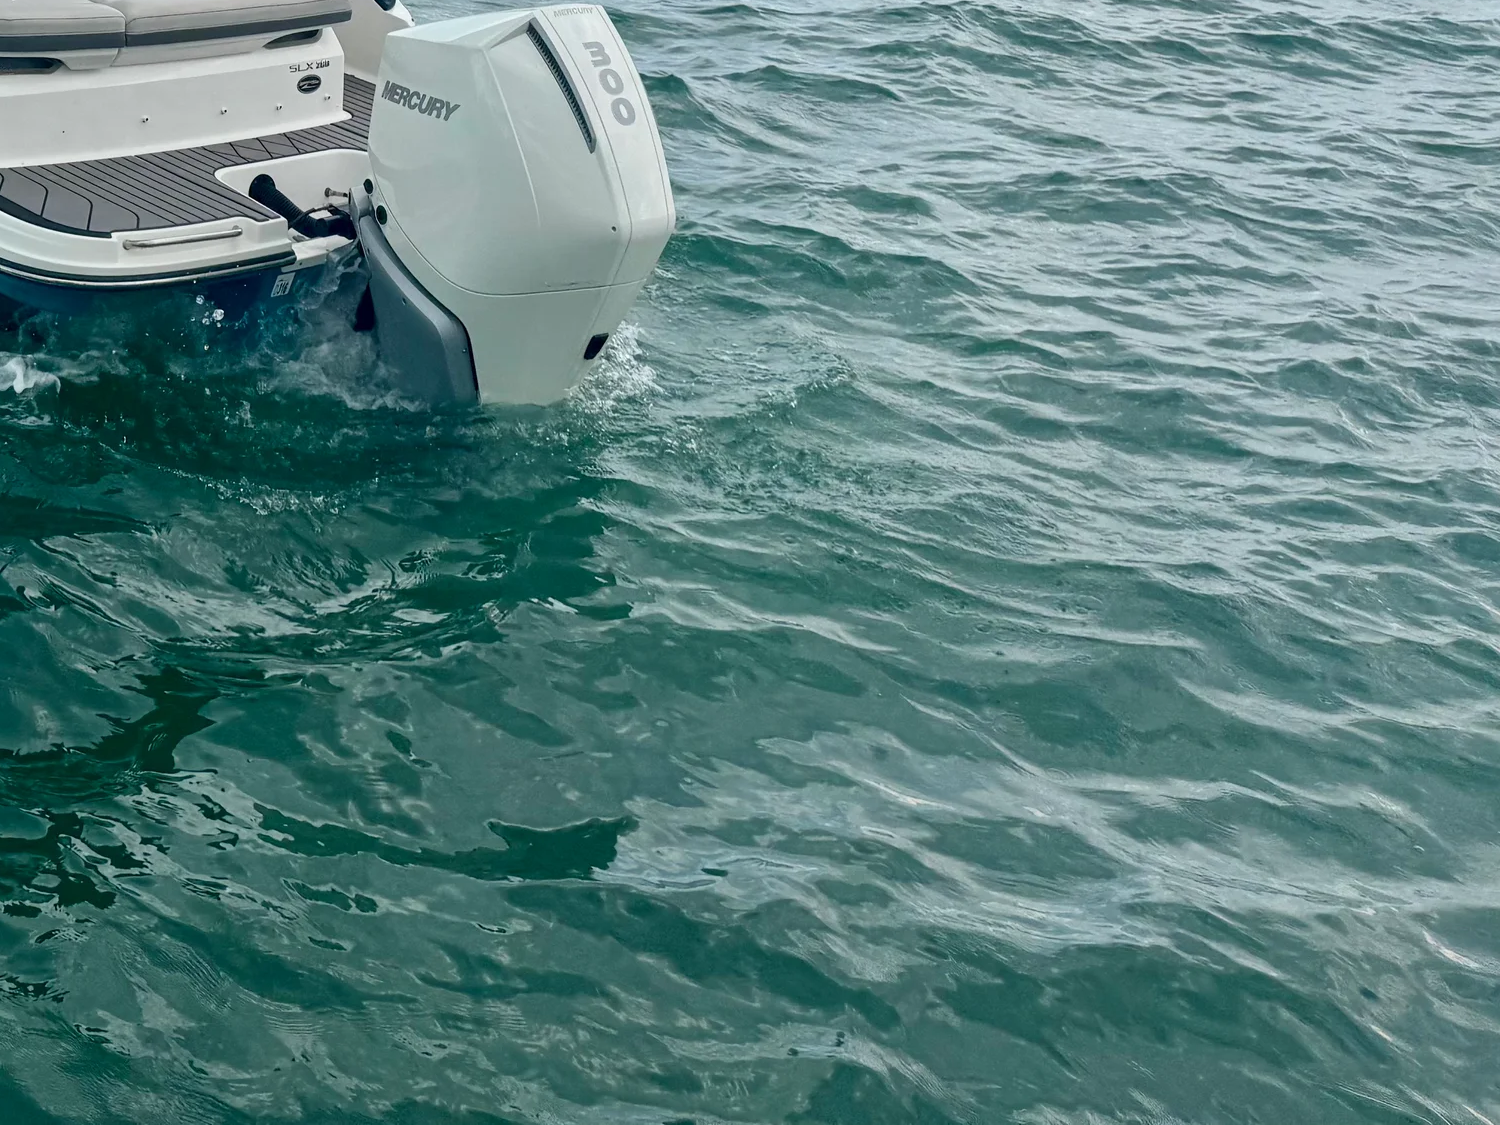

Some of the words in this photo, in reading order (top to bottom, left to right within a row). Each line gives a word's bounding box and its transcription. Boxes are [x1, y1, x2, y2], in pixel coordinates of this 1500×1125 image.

[553, 7, 594, 18] MERCURY
[289, 62, 313, 72] SLX
[582, 41, 636, 126] 300
[381, 80, 461, 122] MERCURY
